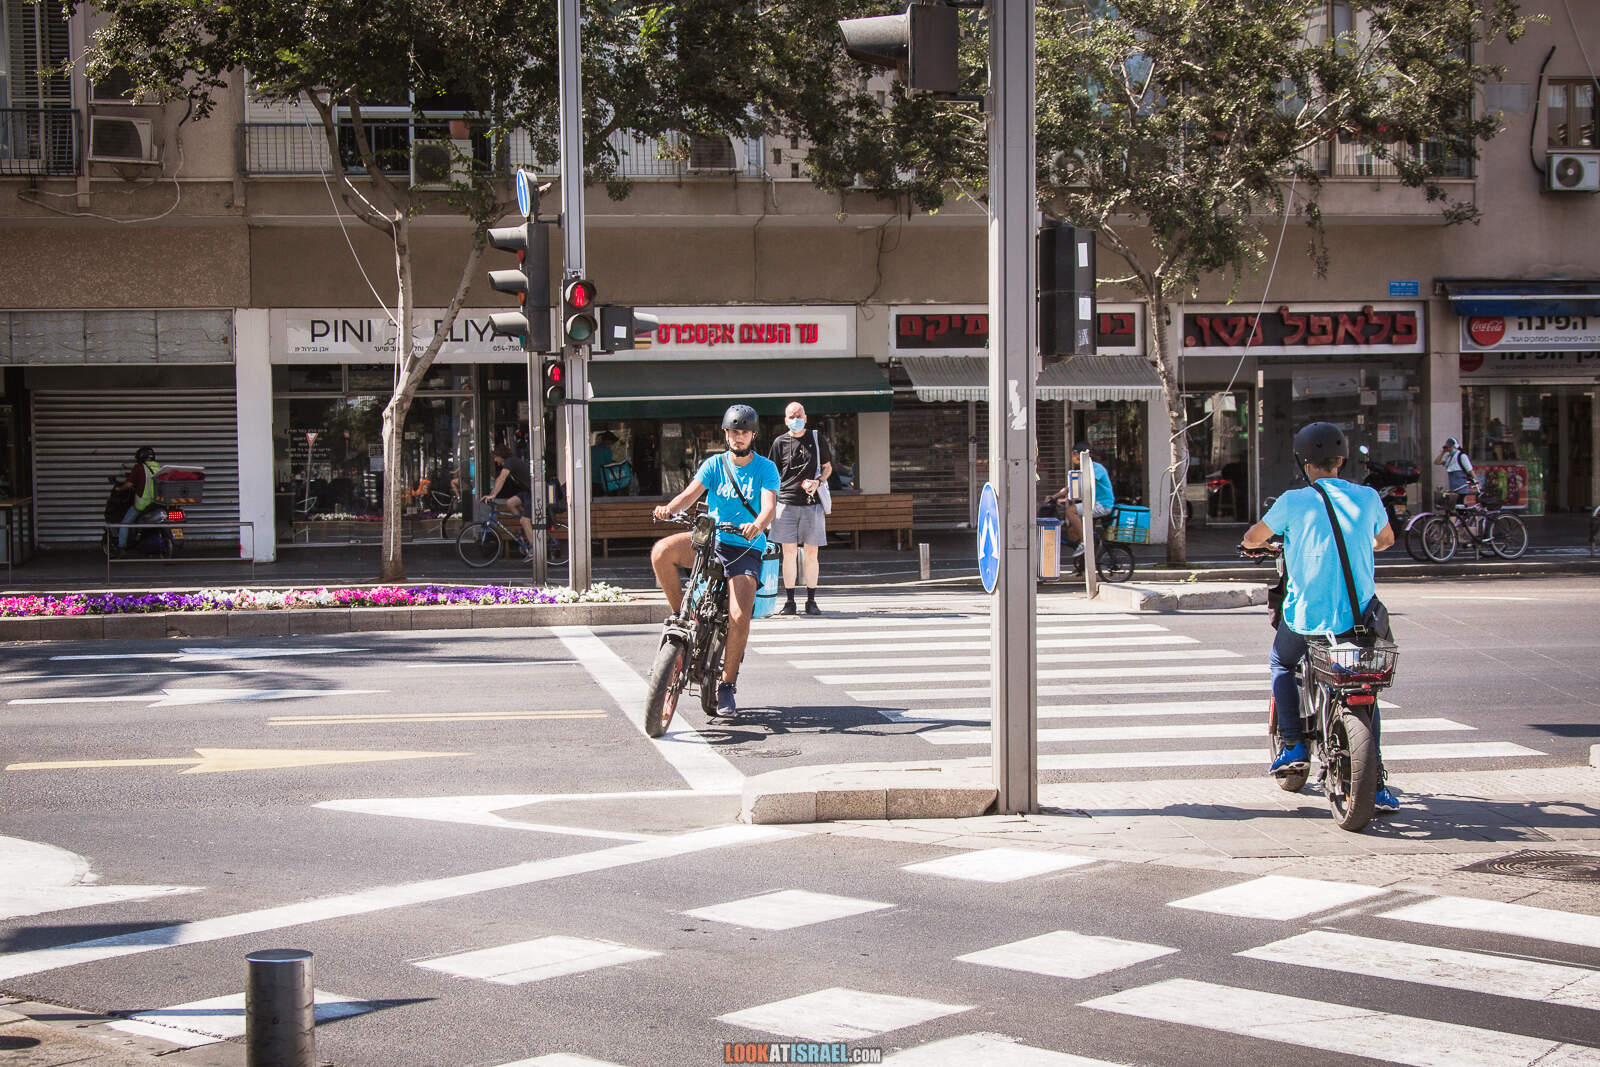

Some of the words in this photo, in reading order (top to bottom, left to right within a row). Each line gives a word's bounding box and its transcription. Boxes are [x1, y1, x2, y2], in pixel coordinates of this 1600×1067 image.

[311, 319, 372, 343] PINI
[739, 323, 791, 344] העצם
[796, 323, 819, 344] עד
[1279, 305, 1418, 345] פלאפל
[1518, 315, 1588, 331] הפינה
[657, 323, 735, 347] אקספרס
